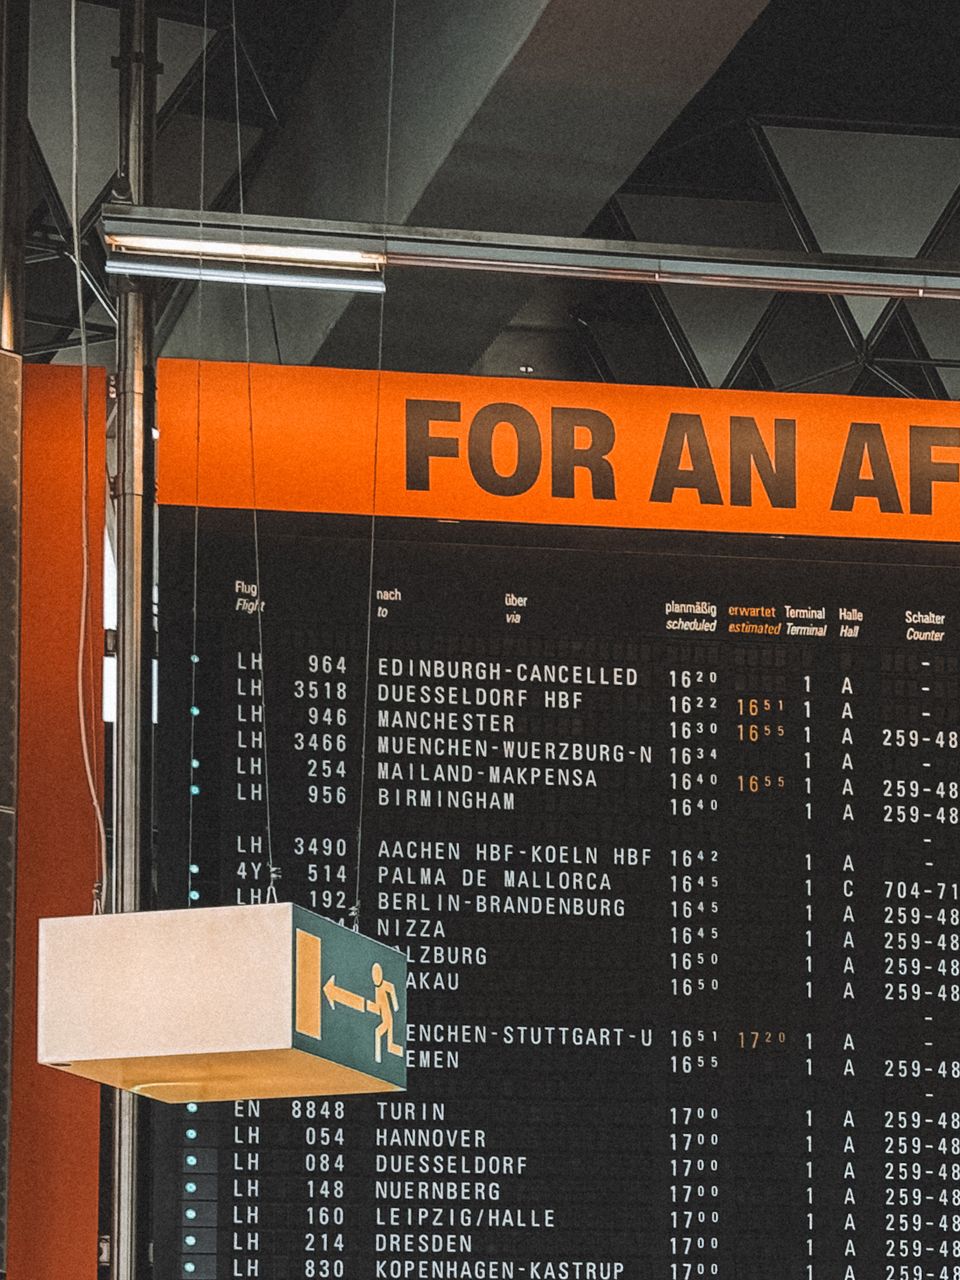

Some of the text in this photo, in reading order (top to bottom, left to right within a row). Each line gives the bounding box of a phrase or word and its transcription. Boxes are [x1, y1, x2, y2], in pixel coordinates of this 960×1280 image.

[406, 400, 615, 499] FOR
[651, 414, 796, 508] AN
[235, 579, 258, 597] Flug
[377, 588, 401, 600] nach
[505, 593, 527, 606] über
[666, 600, 717, 617] planmäßig
[728, 606, 776, 617] erwartet
[784, 605, 825, 619] Terminal
[839, 608, 863, 621] Halle
[905, 611, 945, 624] Schalter
[236, 597, 265, 615] Flight
[378, 607, 388, 617] to
[505, 611, 521, 624] via
[666, 618, 717, 631] scheduled
[729, 621, 782, 635] estimated
[786, 623, 827, 636] Terminal
[840, 625, 859, 637] Hall
[906, 628, 945, 641] Counter
[309, 655, 637, 685] 964 EDINBURGH-CANCELLED
[378, 684, 527, 706] DUESSELDORF
[545, 691, 582, 708] HBF
[379, 710, 513, 732] MANCHESTER
[295, 733, 651, 763] 3466 MUENCHEN-WUERZBURG-N
[378, 762, 596, 786] MAILAND-MAKPENSA
[379, 788, 514, 809] BIRMINGHAM
[379, 841, 650, 865] AACHEN HBF-KOELN HBF
[308, 864, 346, 882] 514
[379, 867, 445, 885] PALMA
[463, 869, 486, 886] DE
[505, 870, 611, 890] MALLORCA
[379, 893, 624, 916] BERLIN-BRANDENBURG
[378, 919, 445, 937] NIZZA
[394, 946, 487, 965] LZBURG
[292, 1100, 444, 1120] 8848 TURIN
[377, 1129, 485, 1147] HANNOVER
[377, 1155, 526, 1174] DUESSELDORF
[376, 1181, 499, 1200] NUERNBERG
[377, 1208, 554, 1227] LEIPZIG/HALLE
[305, 1233, 471, 1252] 214 DRESDEN
[377, 1260, 623, 1280] KOPENHAGEN-KASTRUP
